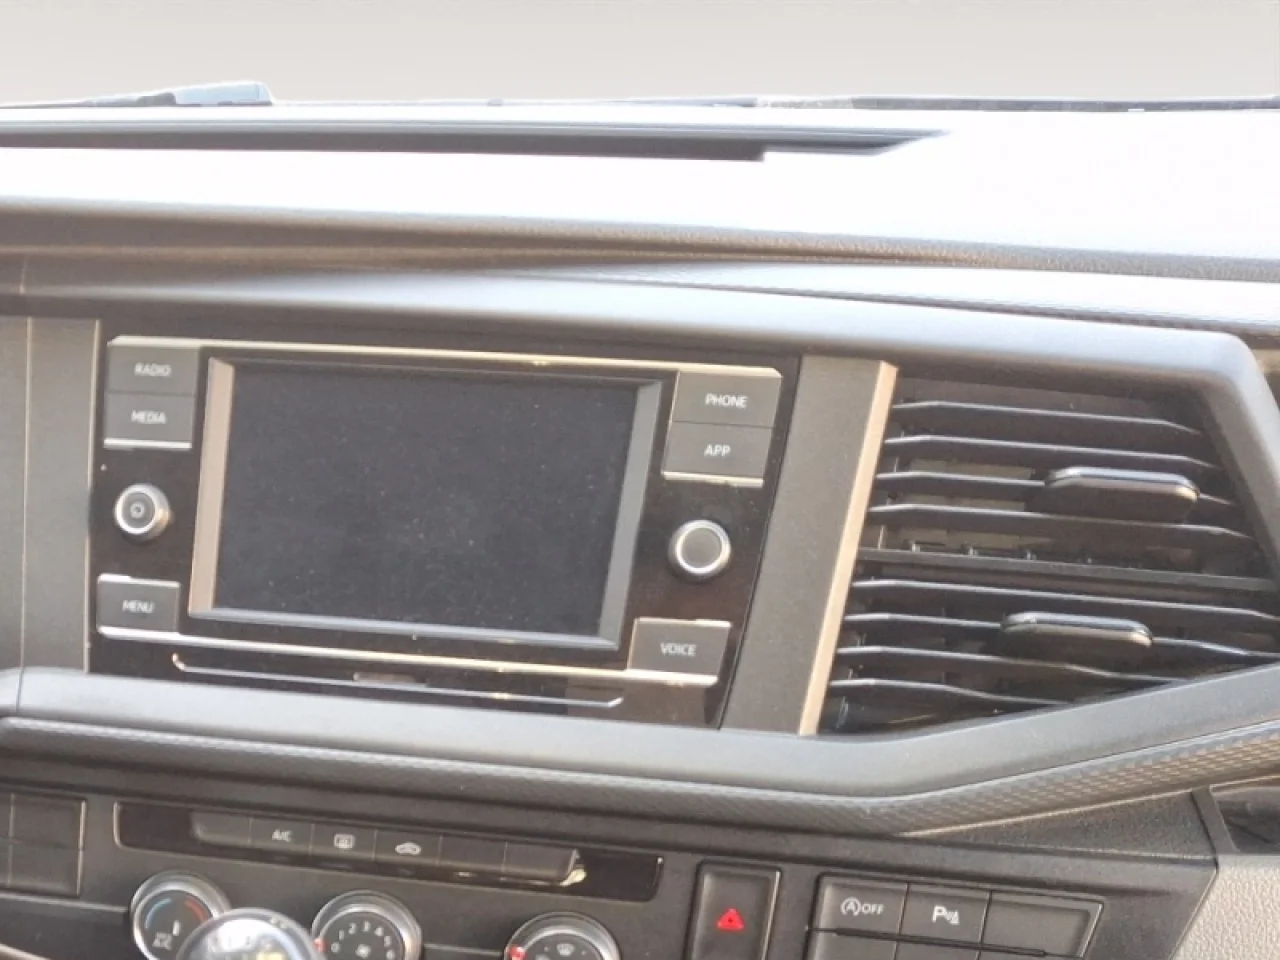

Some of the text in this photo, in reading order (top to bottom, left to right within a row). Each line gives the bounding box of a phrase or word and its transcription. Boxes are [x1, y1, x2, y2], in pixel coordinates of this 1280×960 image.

[134, 362, 171, 376] RADIO
[705, 393, 747, 409] PHONE
[130, 410, 166, 424] MEDIA
[704, 444, 731, 457] APP
[122, 600, 154, 614] MENU
[660, 642, 696, 656] VOICE
[272, 829, 292, 843] A/C
[861, 904, 884, 915] OFF
